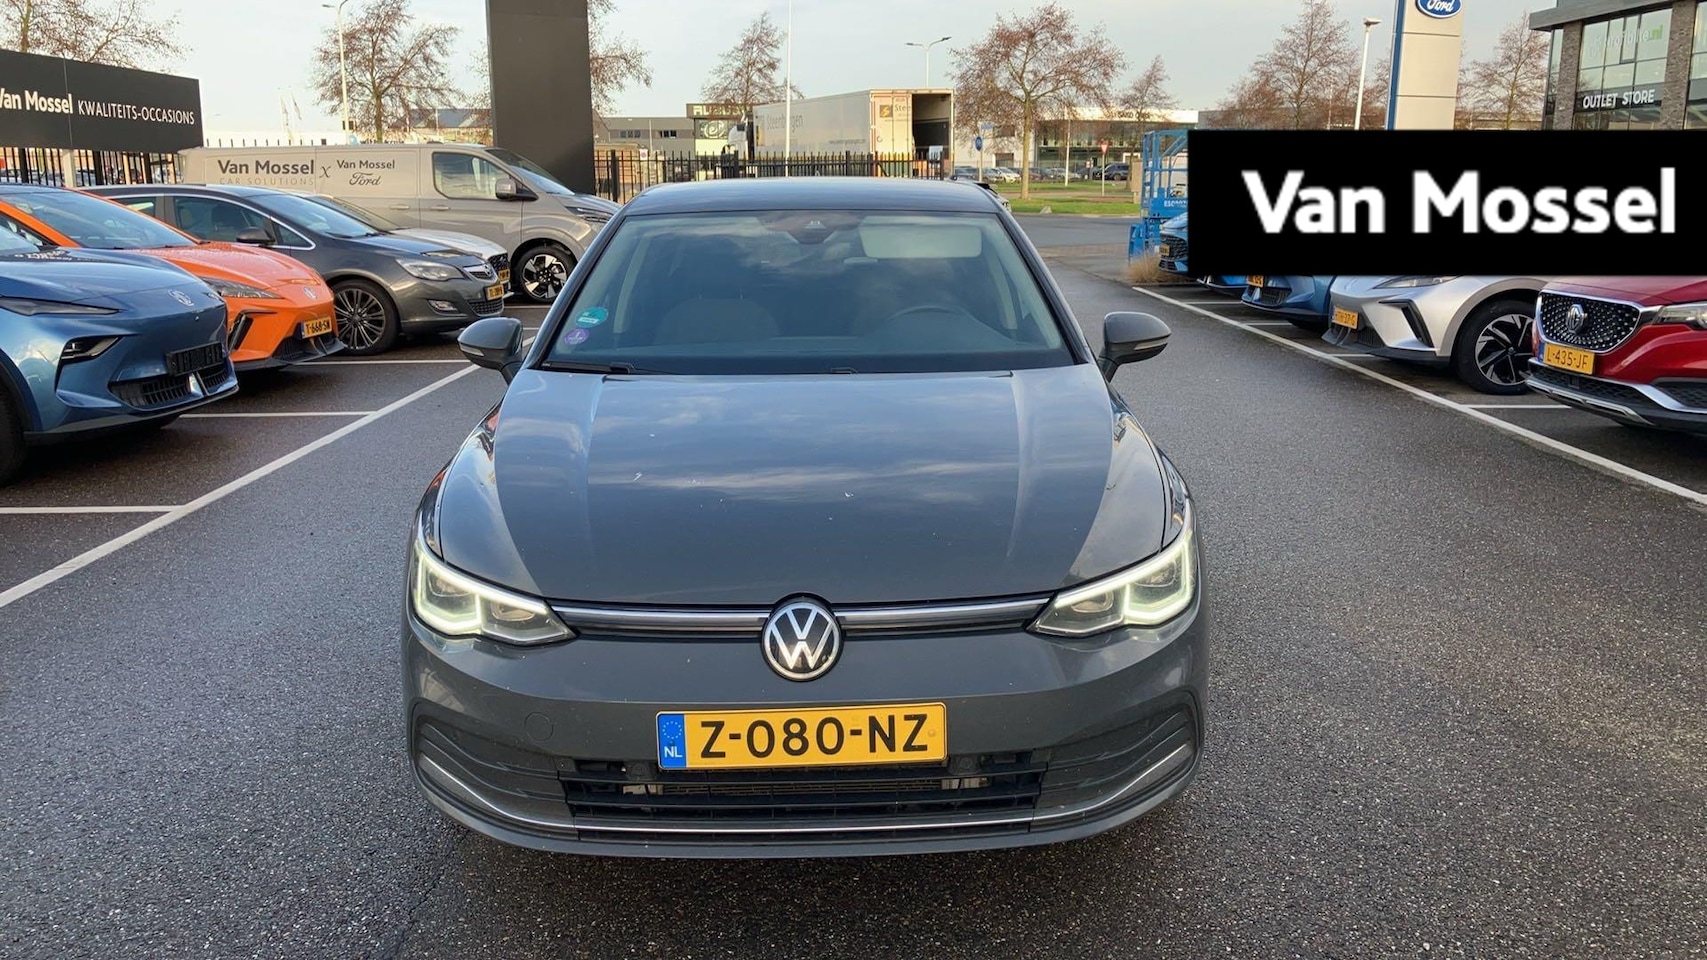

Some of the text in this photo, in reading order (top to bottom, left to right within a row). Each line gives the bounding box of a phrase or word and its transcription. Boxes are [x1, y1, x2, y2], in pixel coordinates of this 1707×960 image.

[1582, 89, 1655, 109] OUTLET STORE
[24, 90, 73, 114] Mossel
[78, 100, 195, 125] KWALITEITS-OCCASIONS
[218, 159, 314, 174] Van Mossel
[337, 159, 395, 169] Van Mossel
[219, 177, 314, 186] CAR SOLUTIONS
[349, 171, 382, 186] Ford
[1547, 347, 1588, 369] L-435-JF
[700, 713, 928, 758] Z-080-NZ
[664, 746, 683, 758] NL
